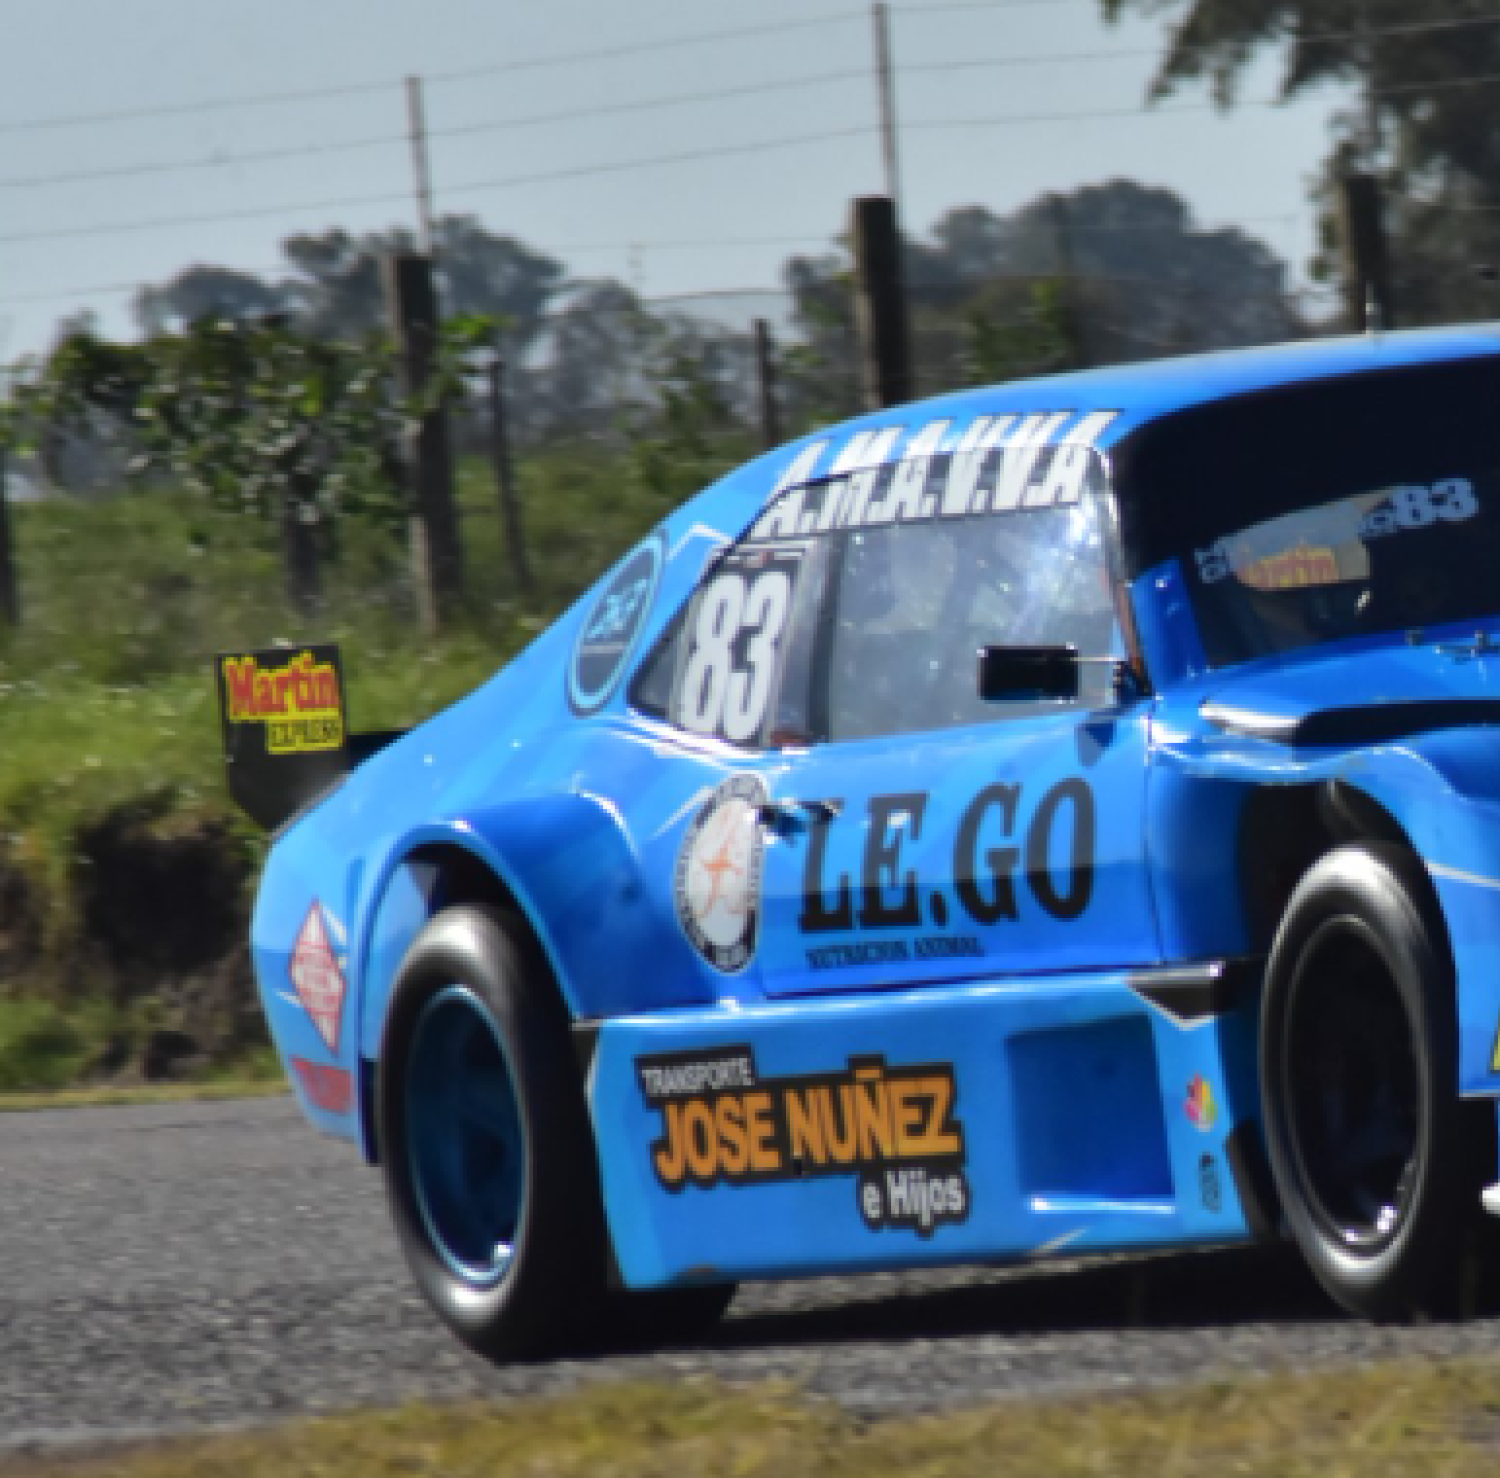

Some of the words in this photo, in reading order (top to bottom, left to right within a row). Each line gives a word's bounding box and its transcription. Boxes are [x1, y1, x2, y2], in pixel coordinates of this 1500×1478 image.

[1391, 476, 1480, 530] 83
[223, 651, 341, 722] Martin
[681, 568, 793, 743] 83
[797, 775, 1097, 934] LE.GO
[914, 934, 986, 960] ANIMAL
[639, 1056, 755, 1097] TRANSPORTE
[656, 1090, 782, 1183] JOSE
[785, 1064, 962, 1166] NUÑEZ
[861, 1181, 881, 1220] e
[886, 1167, 967, 1226] Hijos
